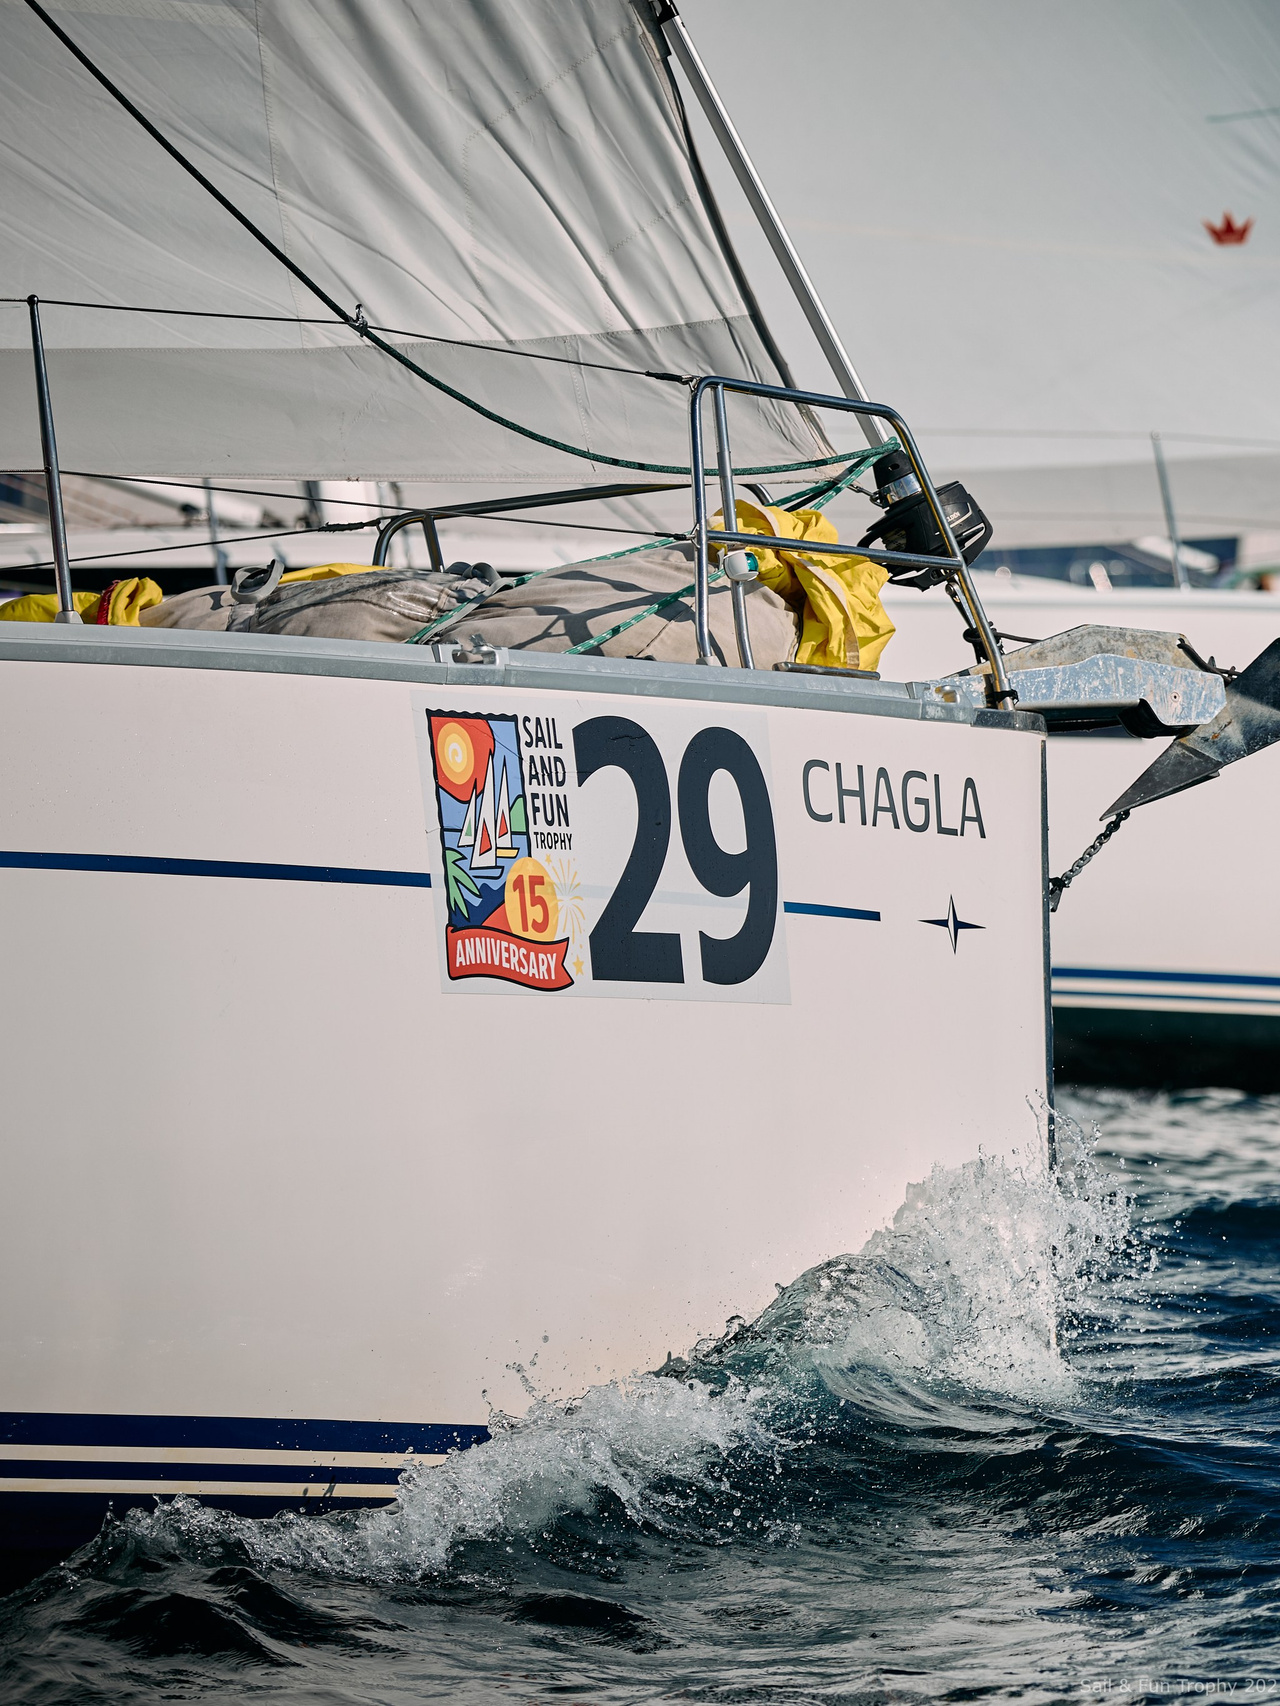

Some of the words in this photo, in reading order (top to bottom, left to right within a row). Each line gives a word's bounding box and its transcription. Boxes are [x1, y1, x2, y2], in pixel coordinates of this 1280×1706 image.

[522, 715, 564, 749] SAIL
[528, 755, 566, 787] AND
[530, 792, 570, 827] FUN
[802, 759, 987, 839] CHAGLA
[533, 831, 573, 850] TROPHY
[571, 715, 778, 986] 29
[512, 874, 550, 934] 15
[455, 936, 557, 980] ANNIVERSARY
